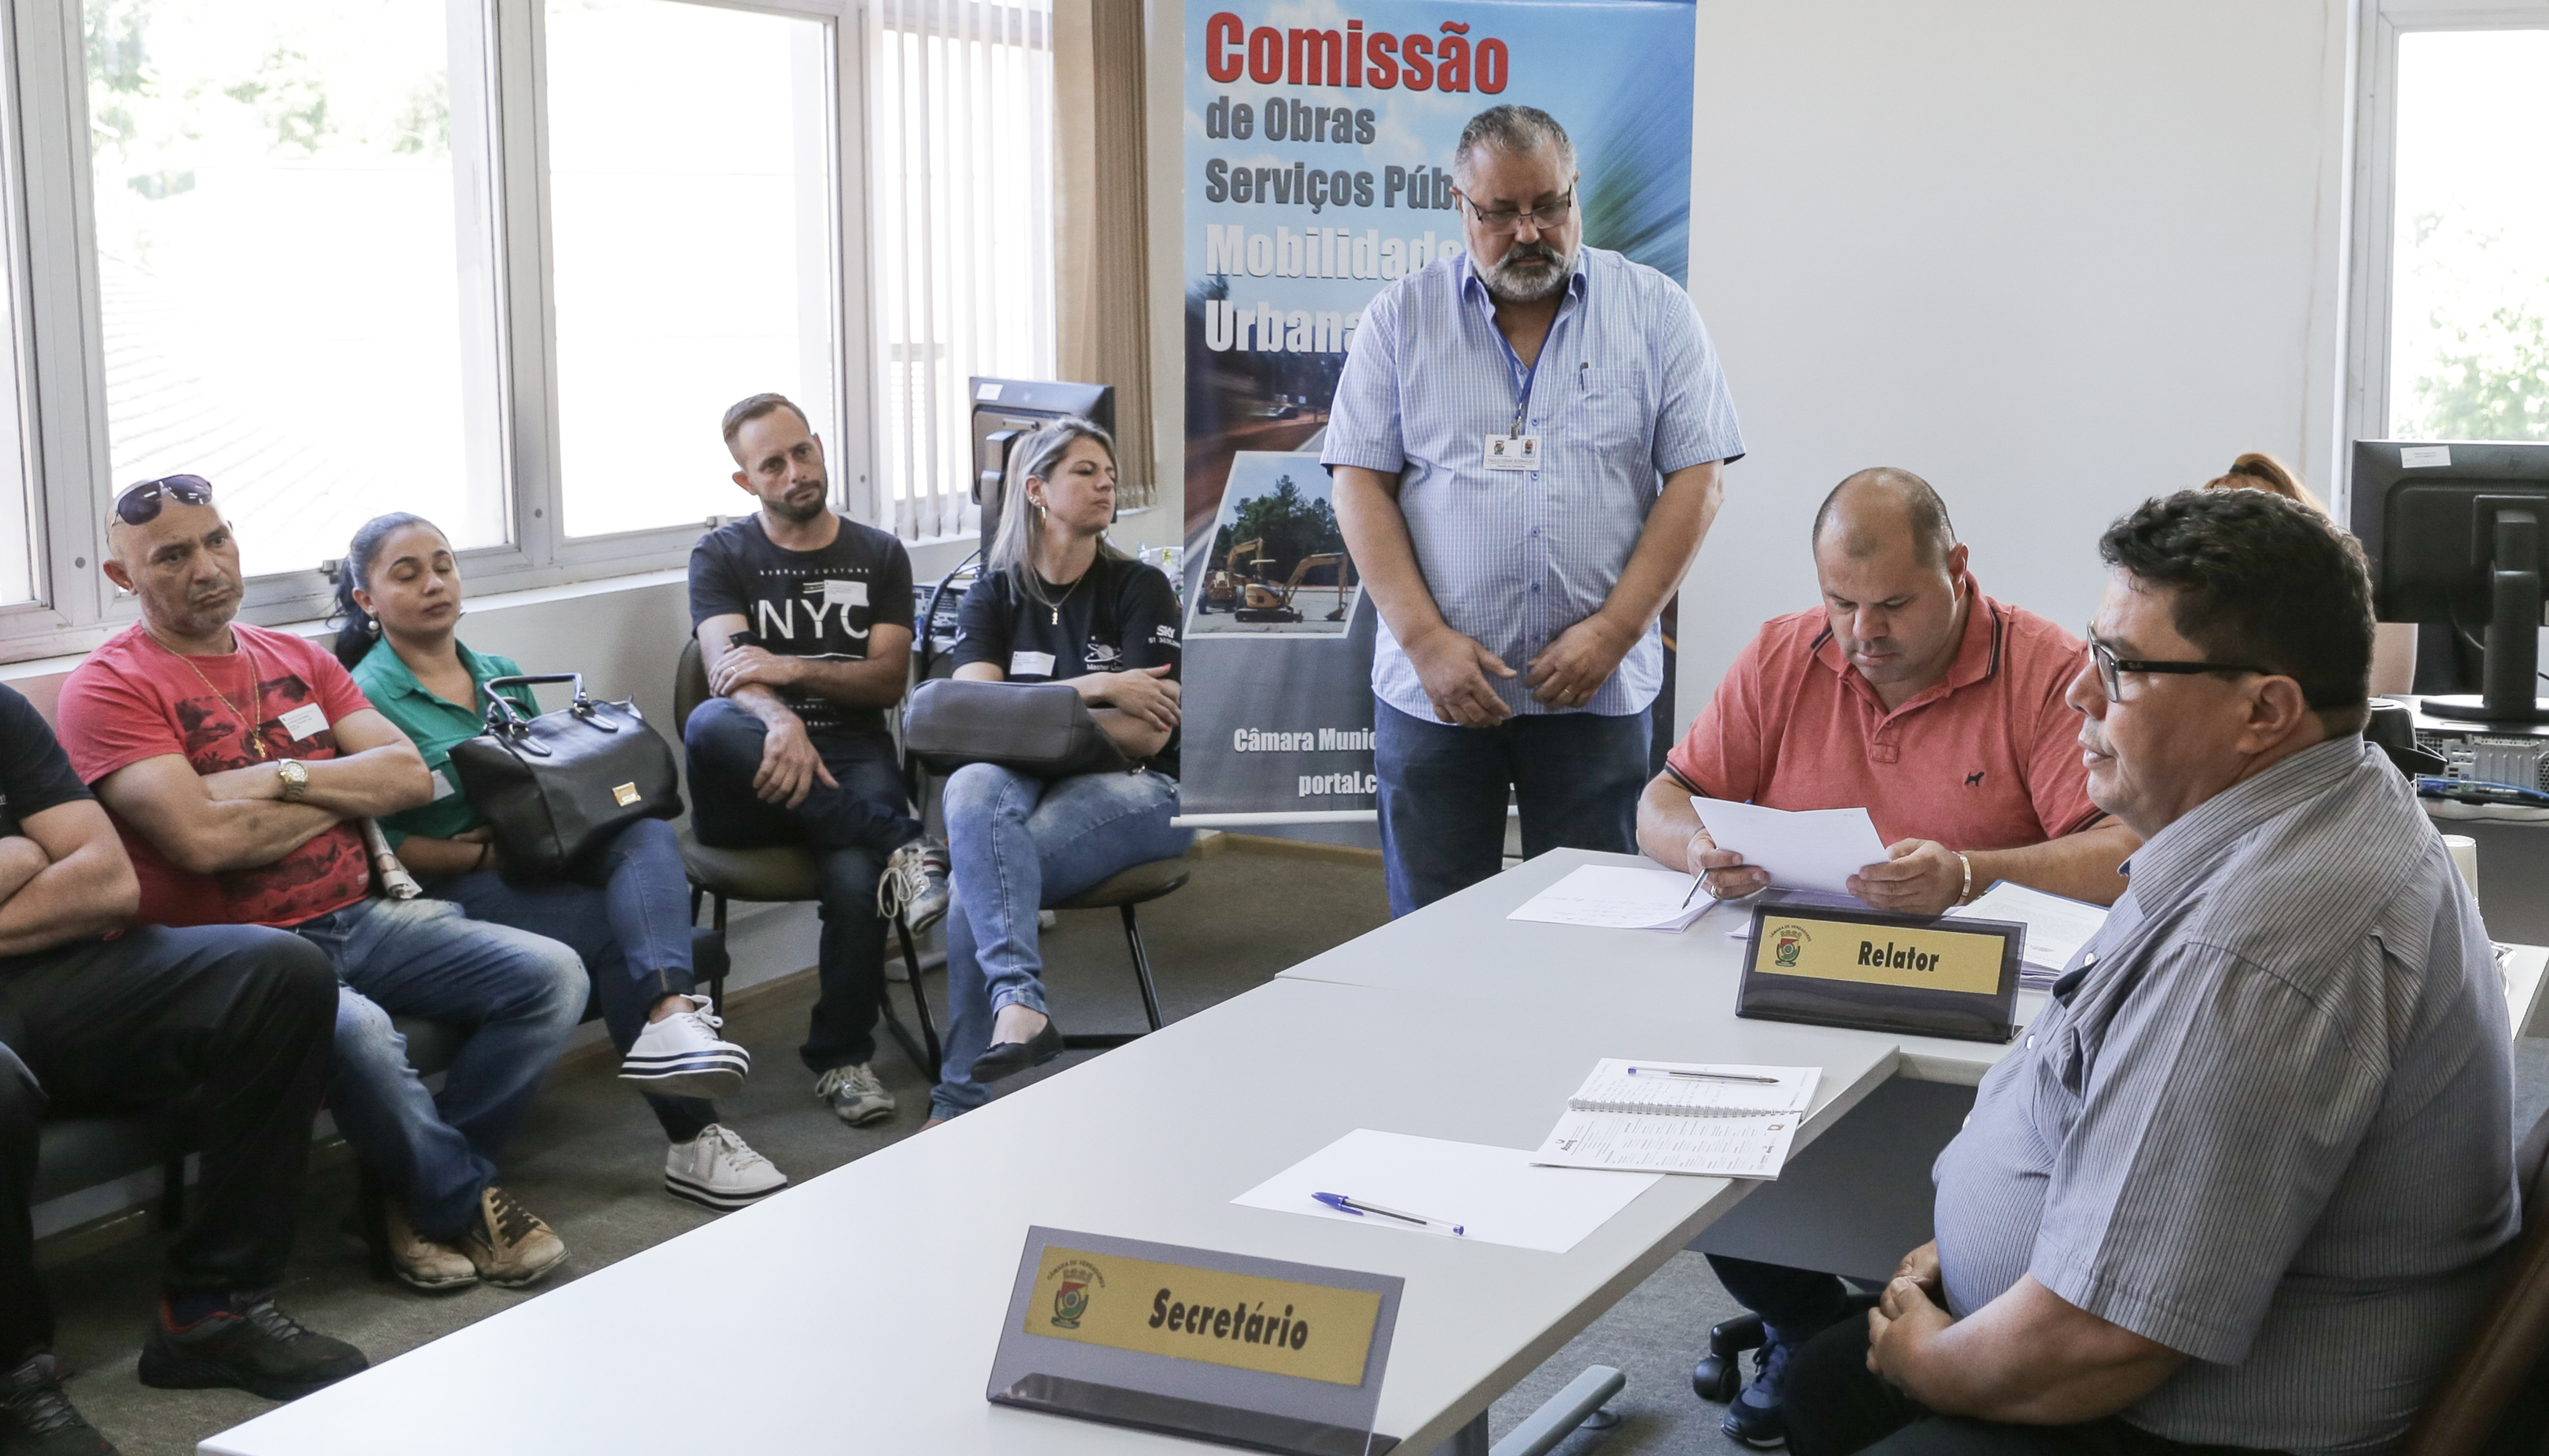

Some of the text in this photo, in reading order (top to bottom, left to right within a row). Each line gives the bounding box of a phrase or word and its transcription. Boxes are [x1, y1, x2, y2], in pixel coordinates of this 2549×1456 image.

[1206, 12, 1508, 94] Comissão
[1206, 96, 1376, 144] de Obras
[1205, 158, 1458, 213] Serviços Púb
[758, 598, 869, 640] NYC
[1156, 624, 1176, 639] SKY
[1234, 727, 1314, 753] Câmara
[1298, 770, 1378, 798] portal.c
[1857, 940, 1940, 973] Relator
[1148, 1288, 1309, 1352] Secretário
